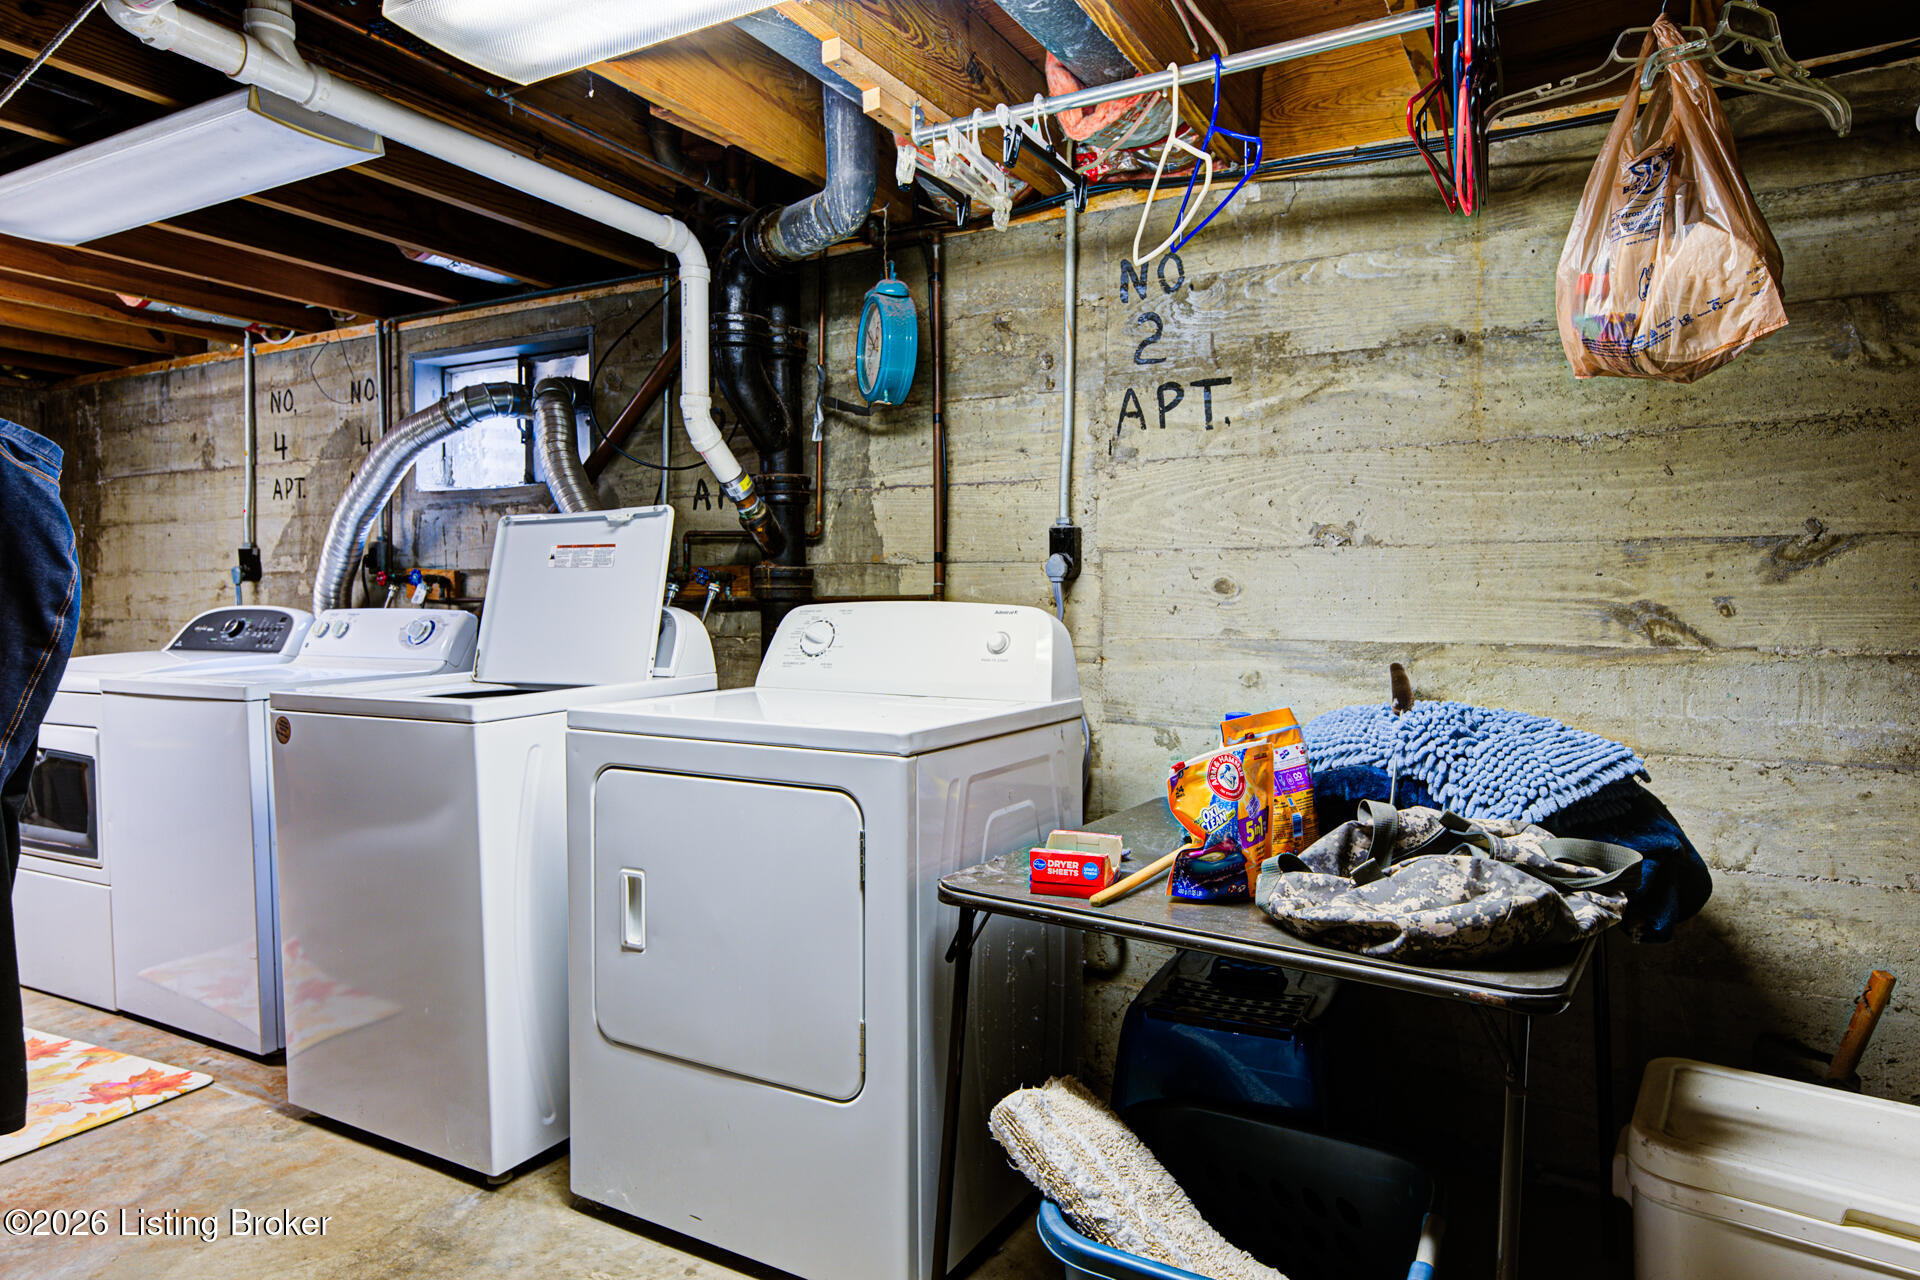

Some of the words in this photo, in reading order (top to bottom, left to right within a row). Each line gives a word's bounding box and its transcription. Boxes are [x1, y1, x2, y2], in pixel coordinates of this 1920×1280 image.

[1120, 253, 1194, 304] NO.
[1134, 312, 1167, 365] 2
[1117, 376, 1233, 437] APT.
[274, 432, 288, 460] 4
[360, 426, 373, 452] 4
[273, 477, 306, 500] APT.
[1047, 860, 1079, 870] DRYER
[1047, 868, 1079, 877] SHEETS
